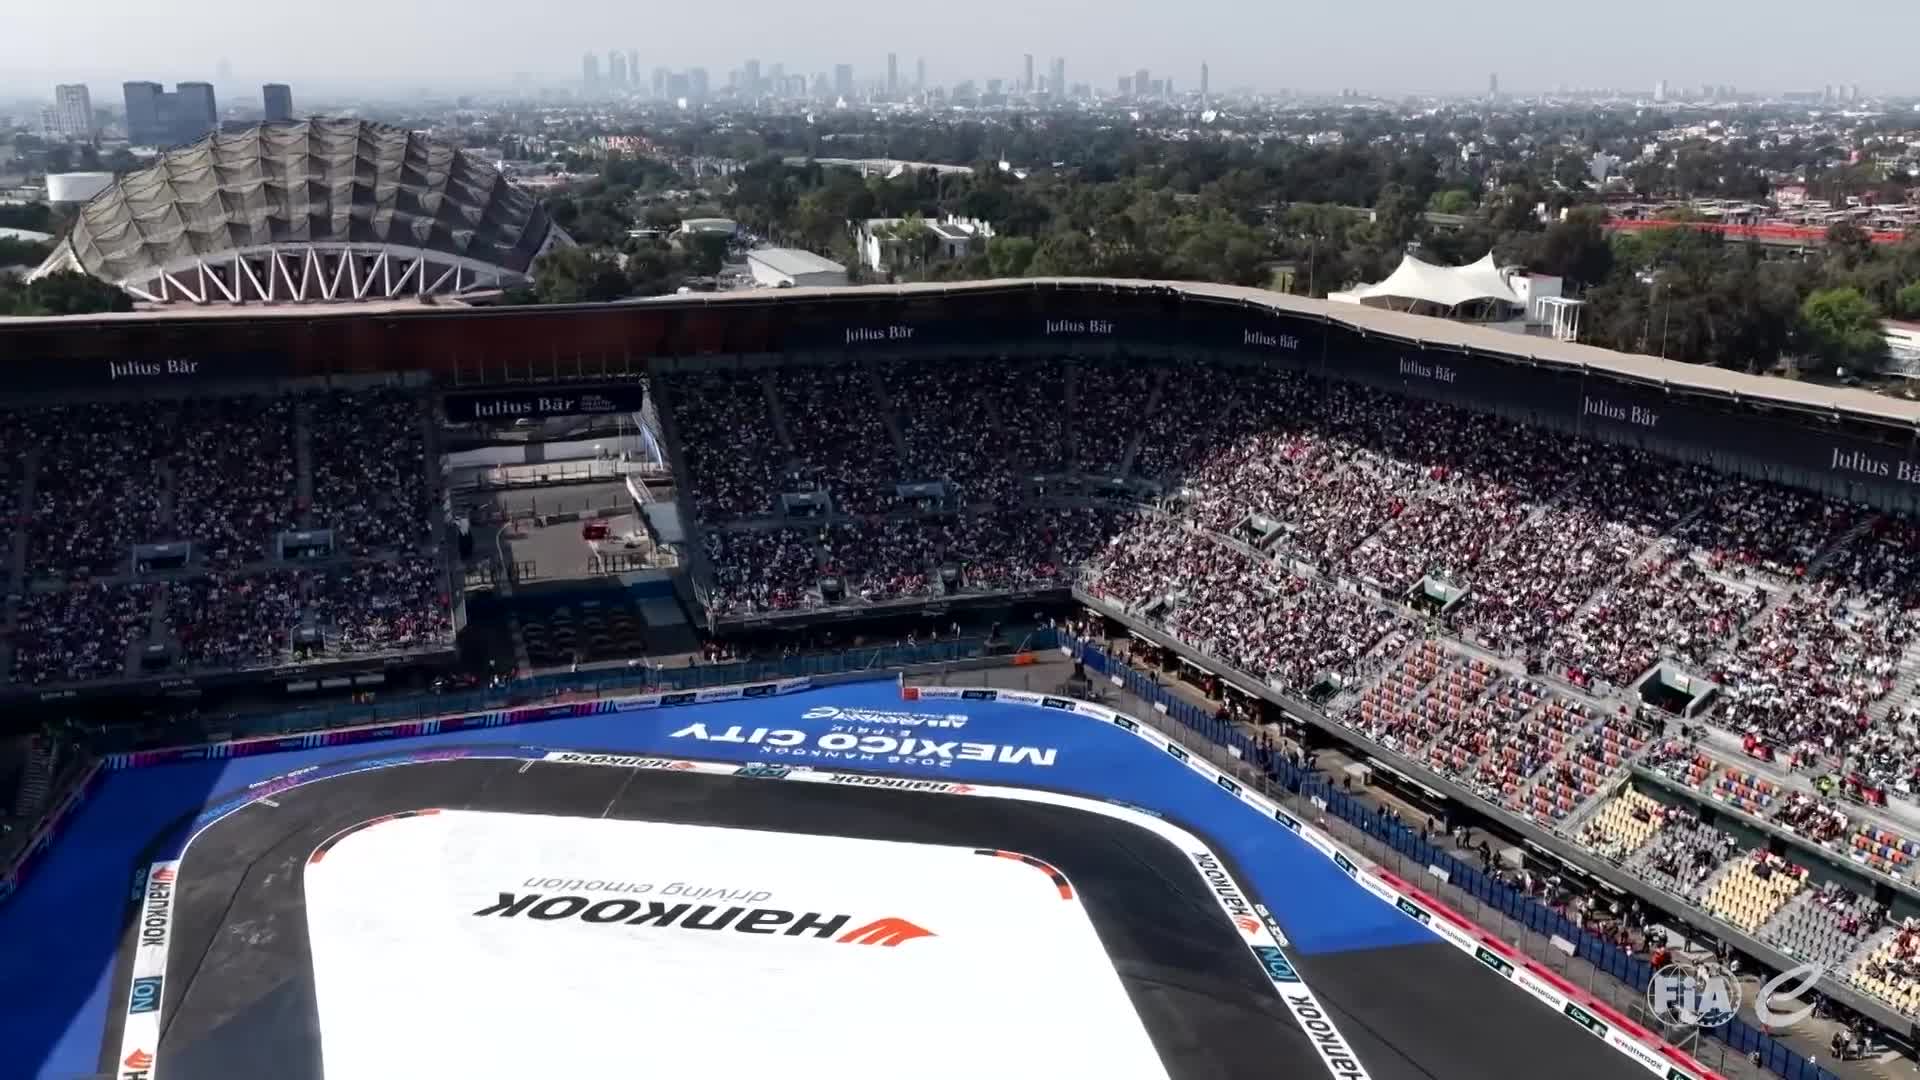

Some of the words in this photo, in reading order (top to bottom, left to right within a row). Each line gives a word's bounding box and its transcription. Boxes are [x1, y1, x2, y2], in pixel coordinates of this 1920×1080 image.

[846, 327, 885, 344] Julius
[1046, 319, 1086, 335] Julius
[110, 360, 160, 380] Julius
[1400, 356, 1432, 377] Julius
[475, 401, 532, 417] Julius
[1584, 396, 1626, 421] Julius
[1631, 406, 1660, 427] Bär
[1832, 447, 1889, 477] Julius
[669, 722, 808, 748] CITY
[818, 731, 1058, 766] MEXICO
[522, 876, 655, 894] emotion
[661, 880, 773, 902] driving
